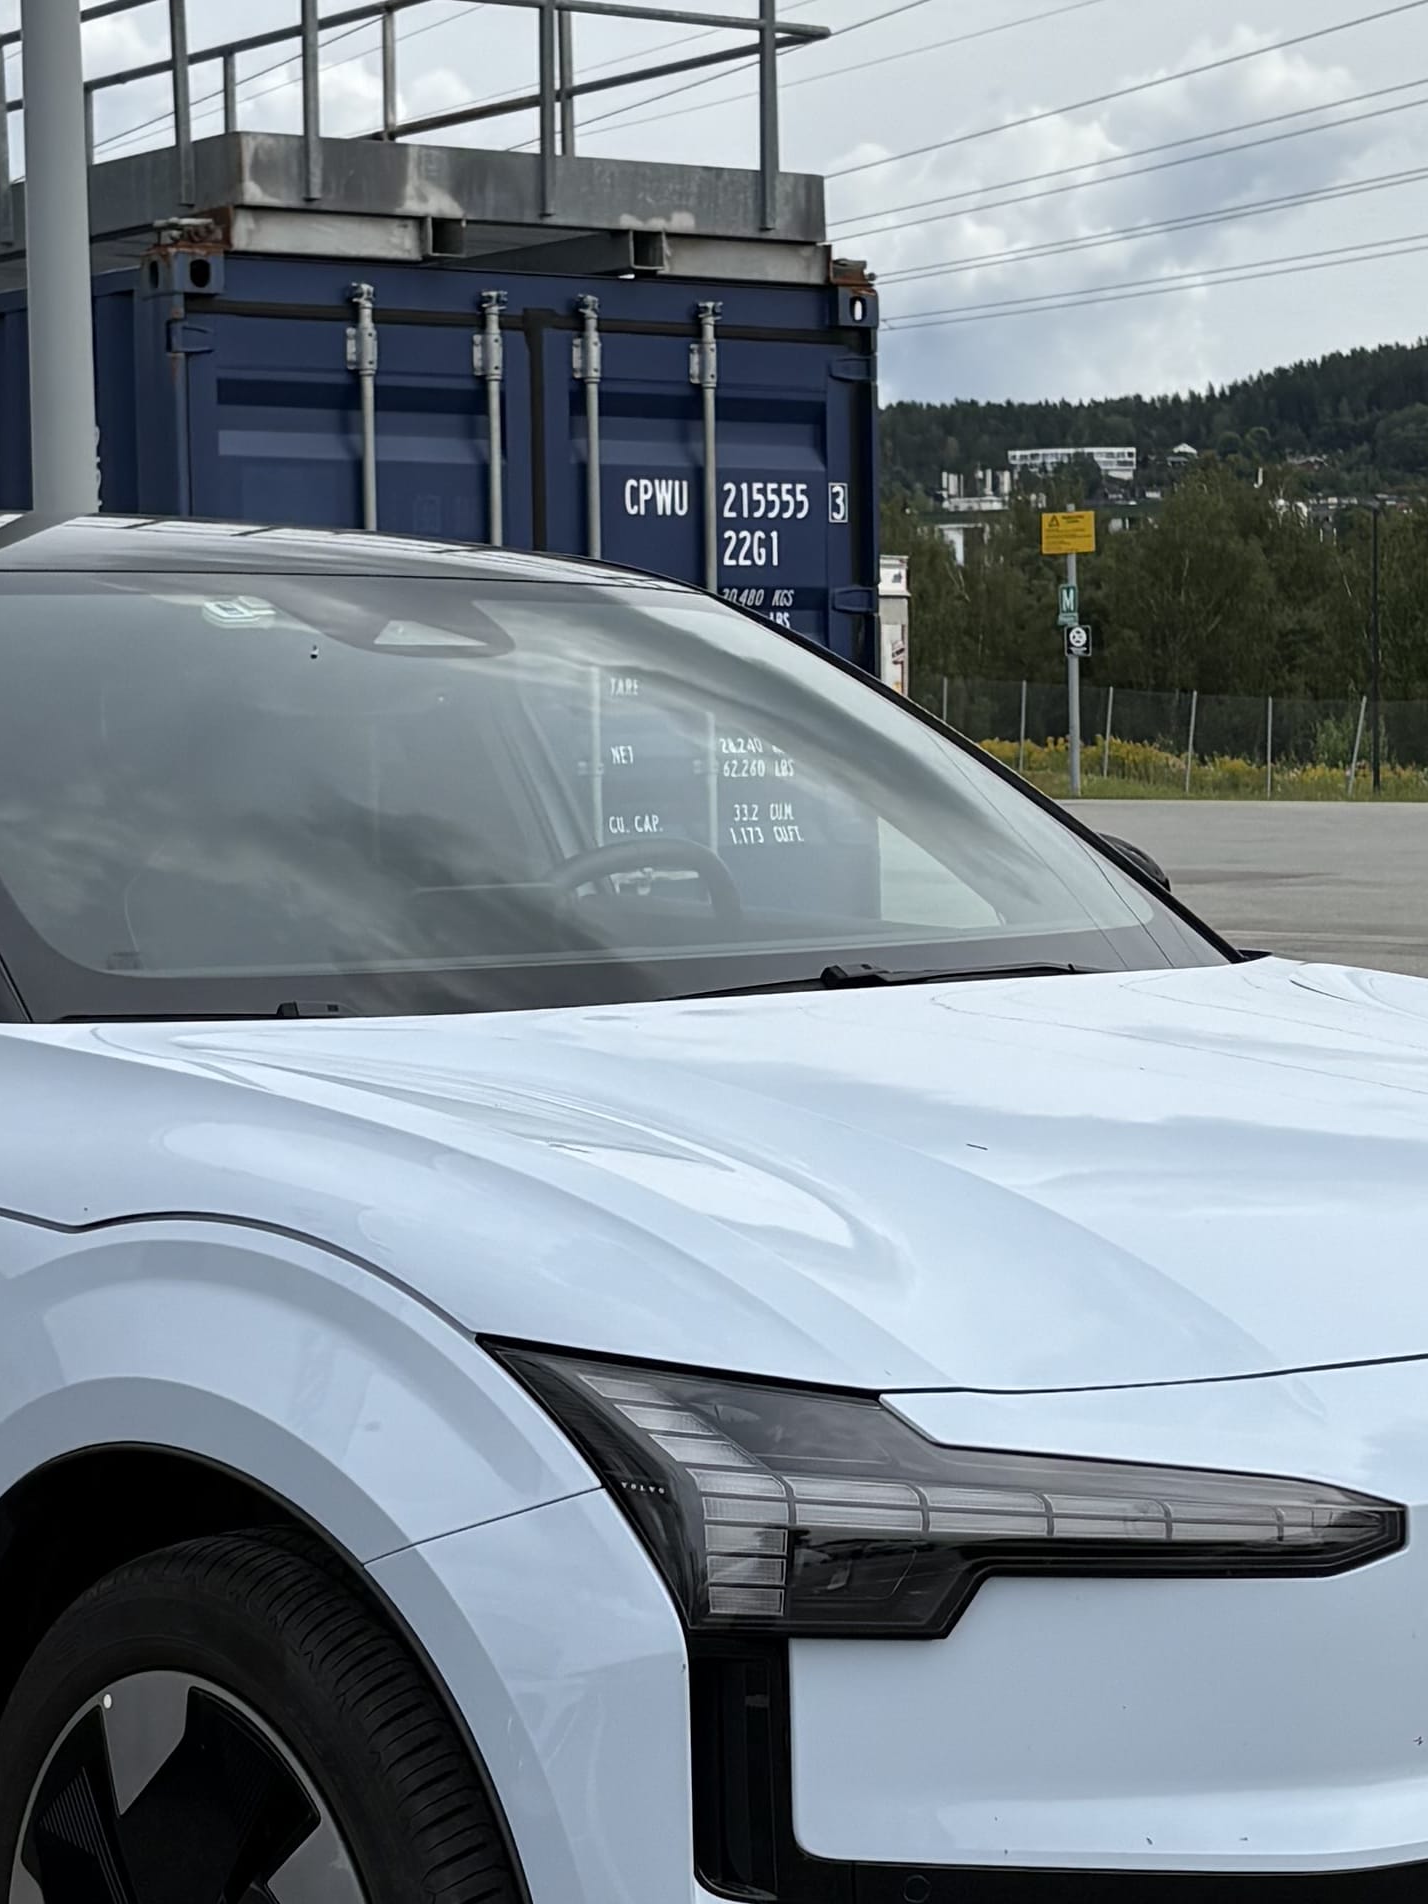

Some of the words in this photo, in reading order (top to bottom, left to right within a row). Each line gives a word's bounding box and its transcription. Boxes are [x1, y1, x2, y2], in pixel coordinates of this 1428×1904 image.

[624, 478, 689, 516] CPWU
[722, 482, 810, 519] 215555
[831, 485, 846, 520] 3
[723, 530, 779, 567] 22G1
[723, 588, 765, 607] 30480
[772, 589, 795, 607] KGS
[1062, 588, 1075, 612] M
[610, 744, 634, 764] NET
[723, 759, 766, 778] 62.260
[774, 759, 795, 777] LBS
[733, 803, 759, 822] 33.2
[634, 813, 664, 833] CAP.
[730, 826, 765, 844] 1.173
[621, 1481, 666, 1495] VOLVO
